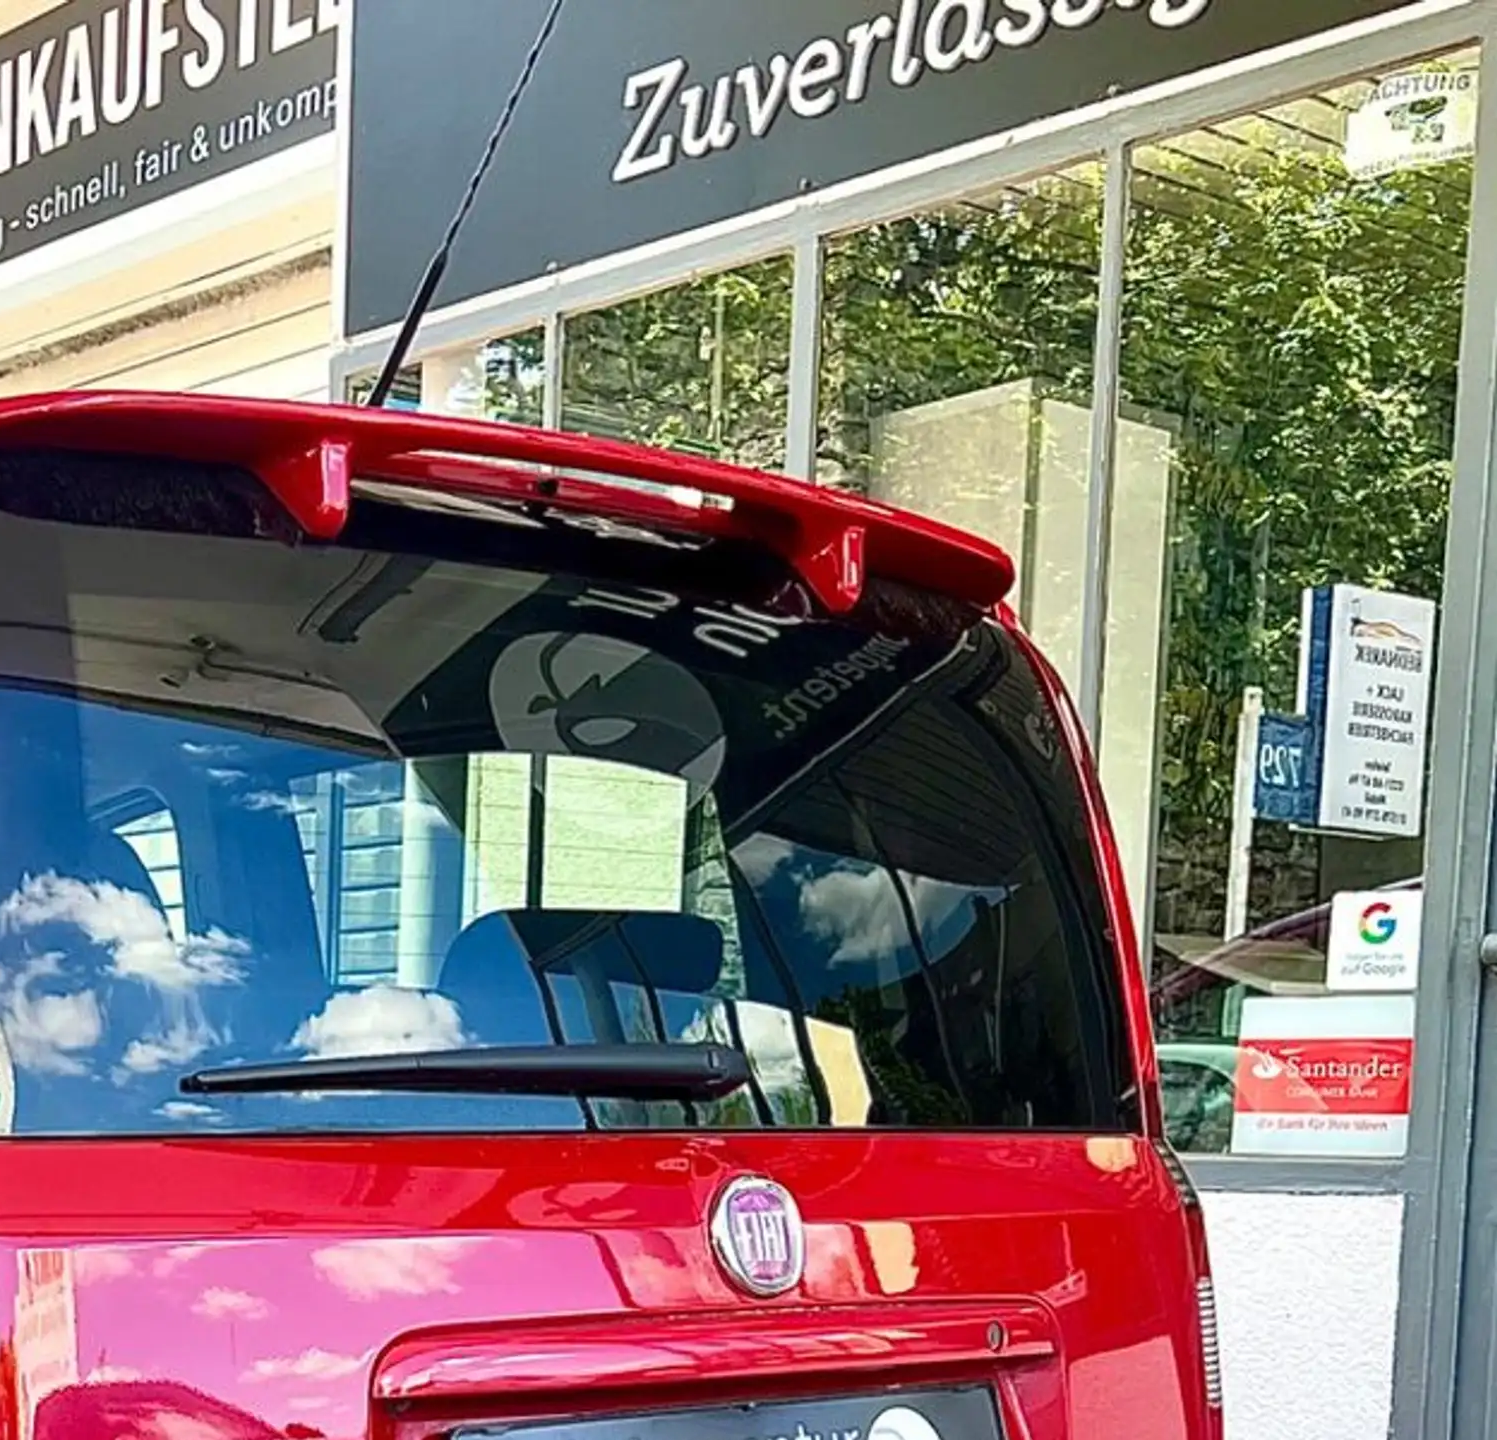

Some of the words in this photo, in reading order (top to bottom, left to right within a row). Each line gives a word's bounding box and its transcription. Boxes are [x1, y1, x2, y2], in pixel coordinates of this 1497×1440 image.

[1368, 73, 1471, 104] ACHTUNG
[25, 160, 127, 230] schnell,
[134, 140, 183, 187] fair
[189, 124, 210, 164] &
[1362, 961, 1407, 978] Google
[1285, 1055, 1403, 1079] Santander
[735, 1209, 788, 1262] FIAT
